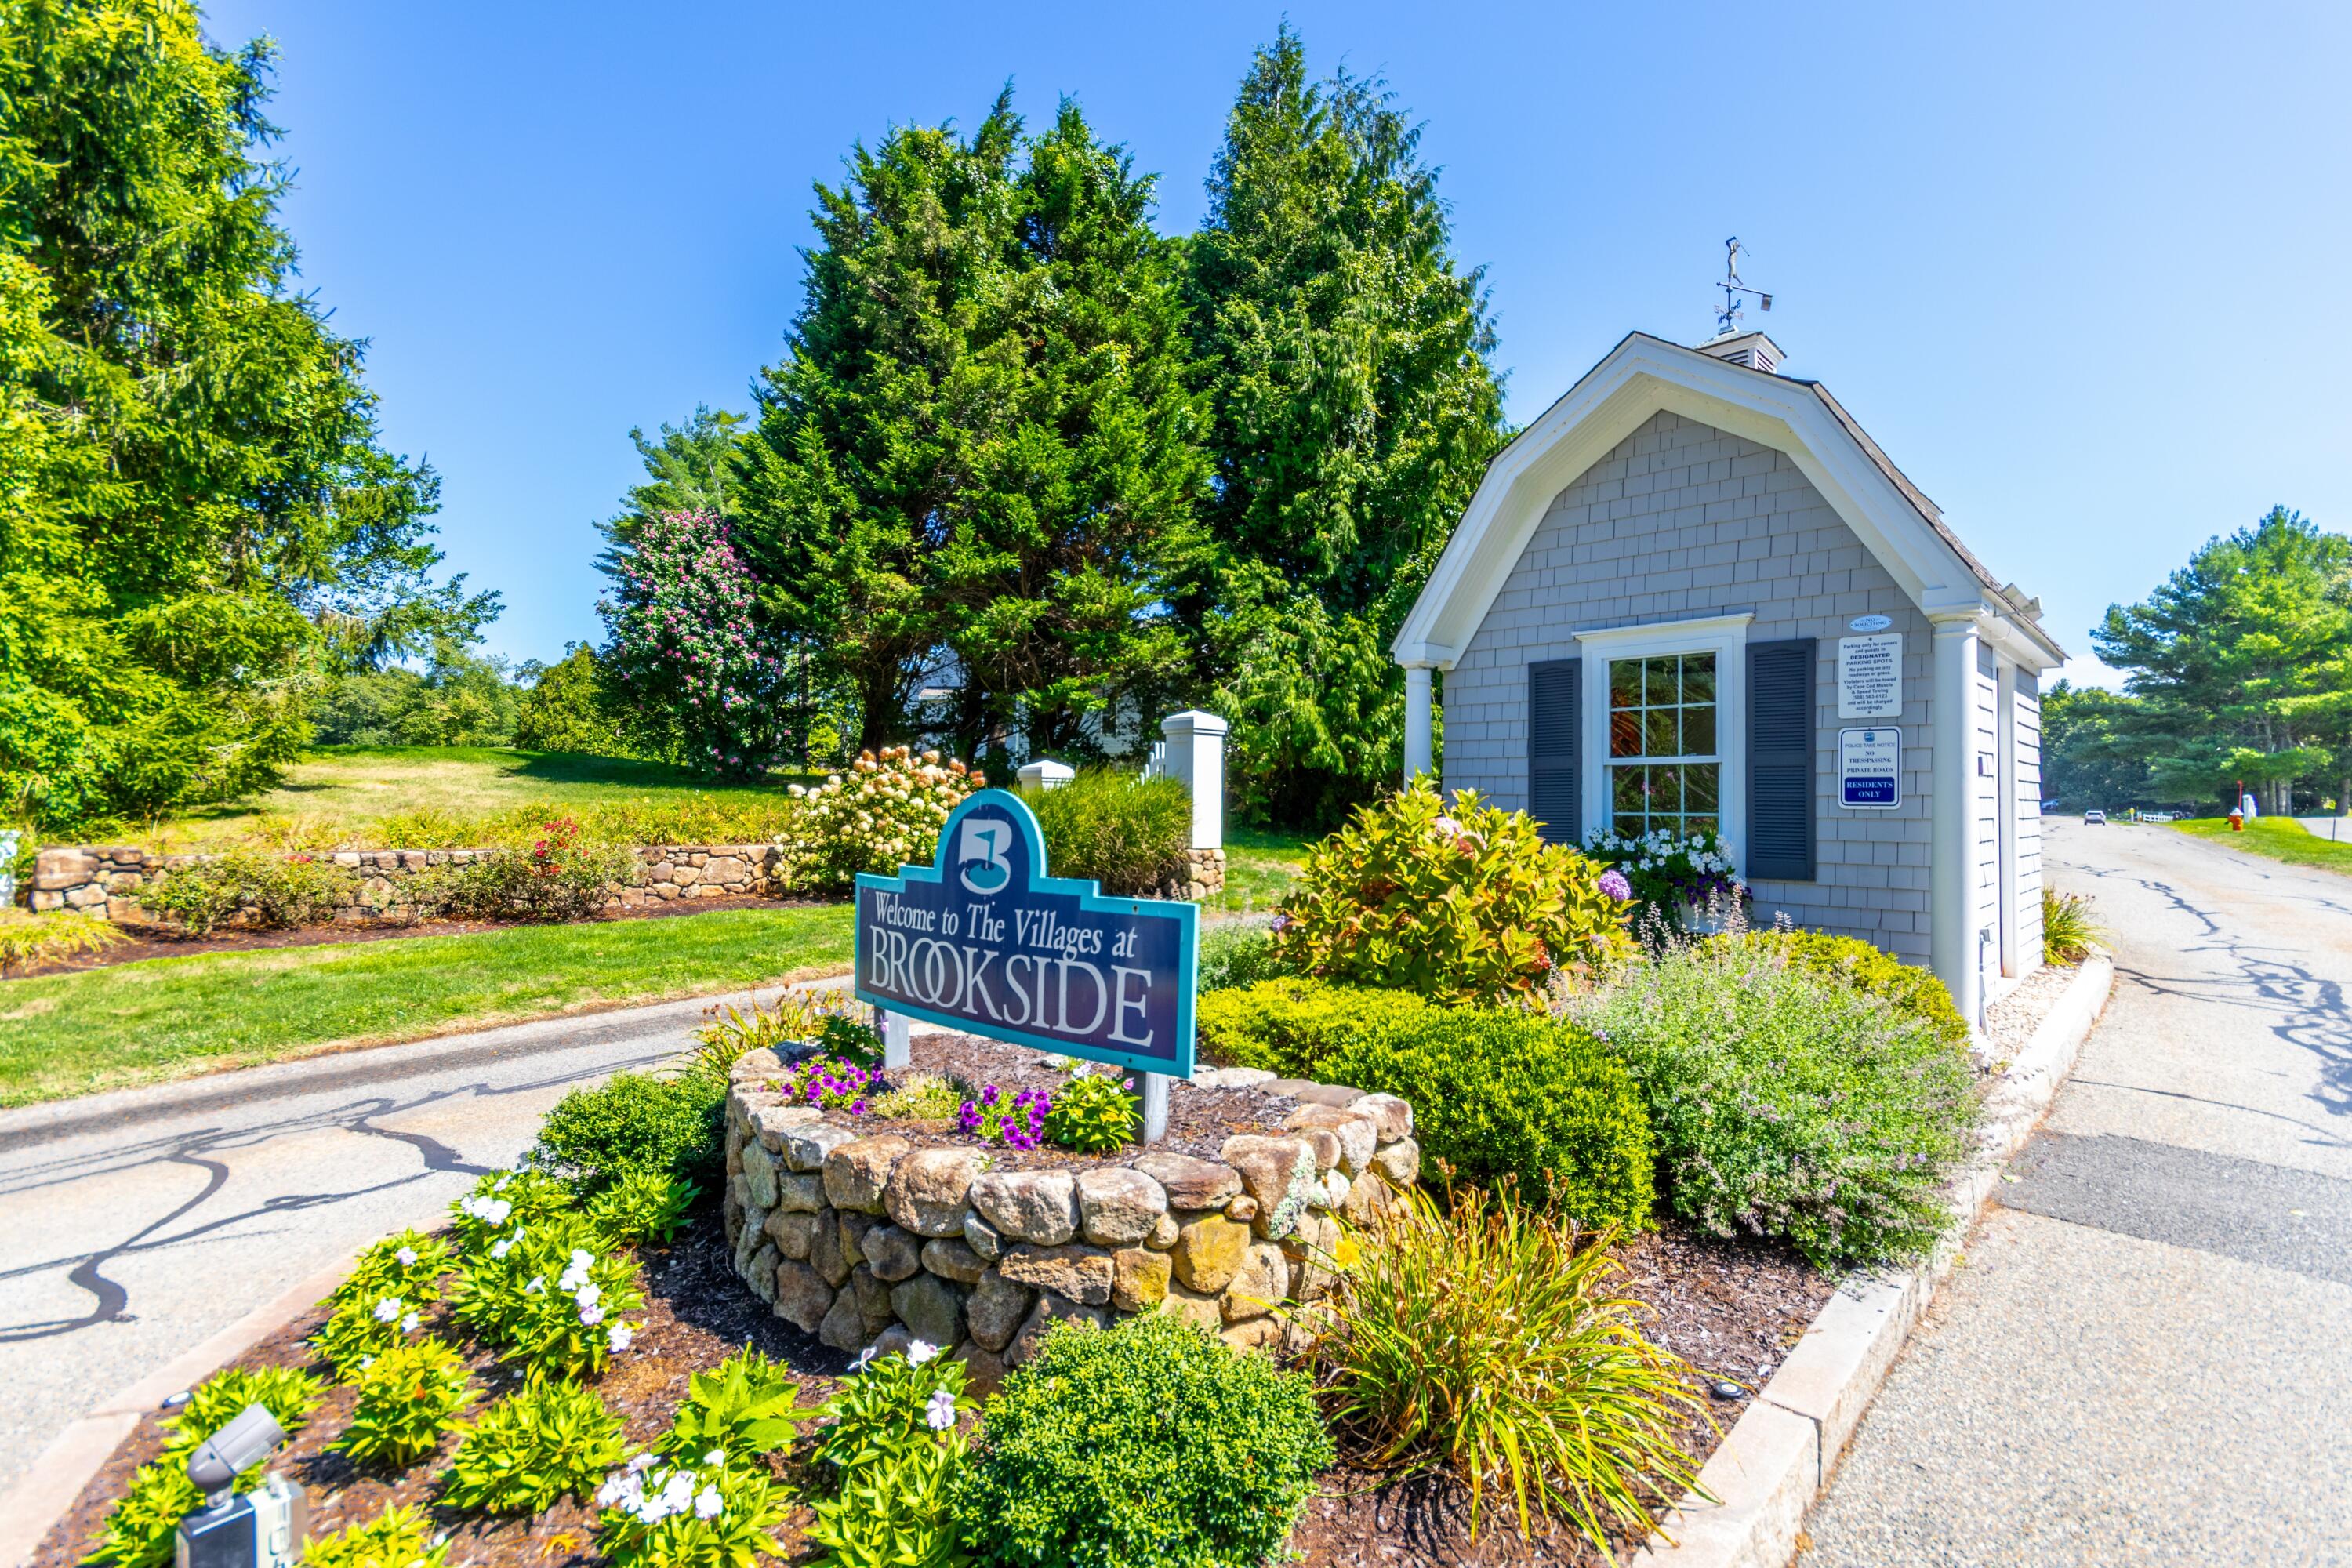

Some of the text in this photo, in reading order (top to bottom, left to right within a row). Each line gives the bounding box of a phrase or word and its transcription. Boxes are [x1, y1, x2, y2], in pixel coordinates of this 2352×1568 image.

[876, 892, 1137, 962] Welcome to The Villages at
[869, 925, 1154, 1048] BROOKSIDE
